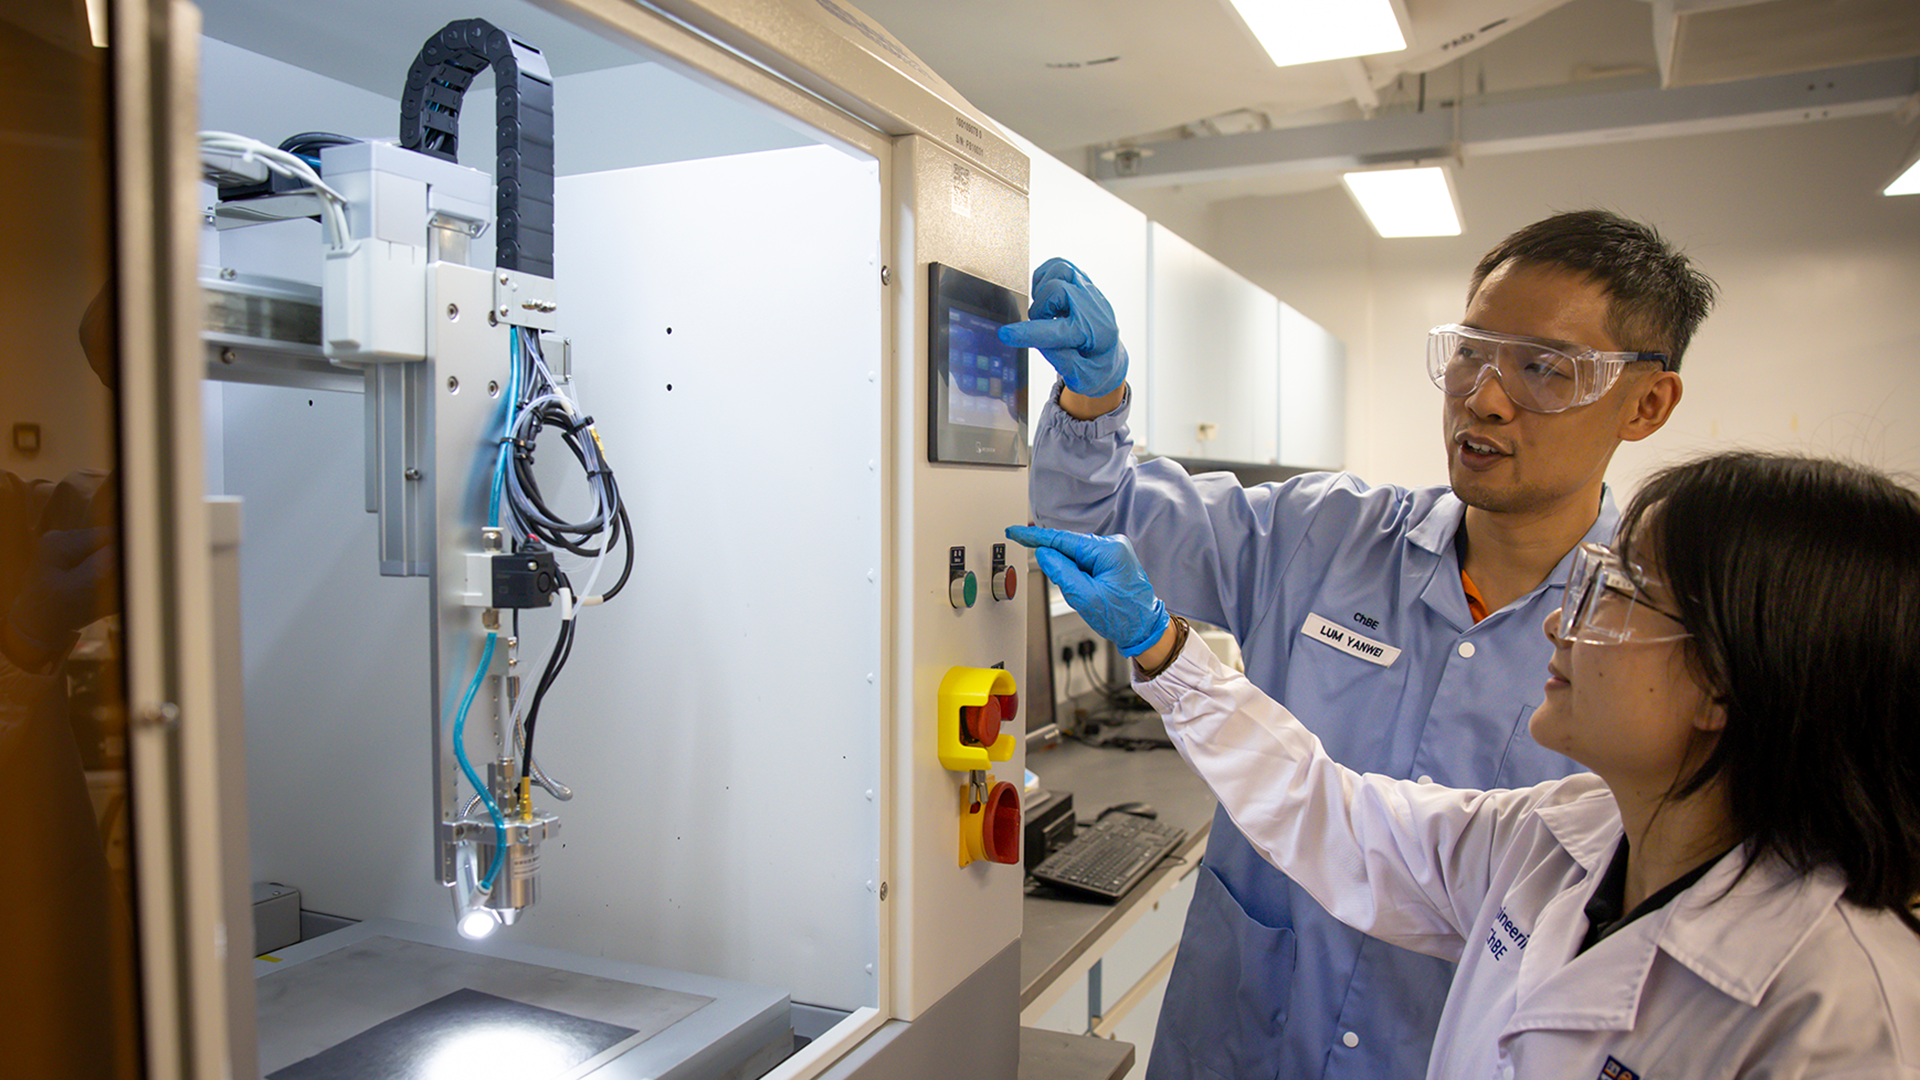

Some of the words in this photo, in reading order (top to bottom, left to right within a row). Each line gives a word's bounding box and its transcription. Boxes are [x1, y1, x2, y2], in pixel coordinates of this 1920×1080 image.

[1353, 612, 1380, 630] ChBE
[1320, 625, 1344, 642] LUM
[1347, 636, 1384, 658] YANWEI
[1495, 907, 1530, 950] ineeri
